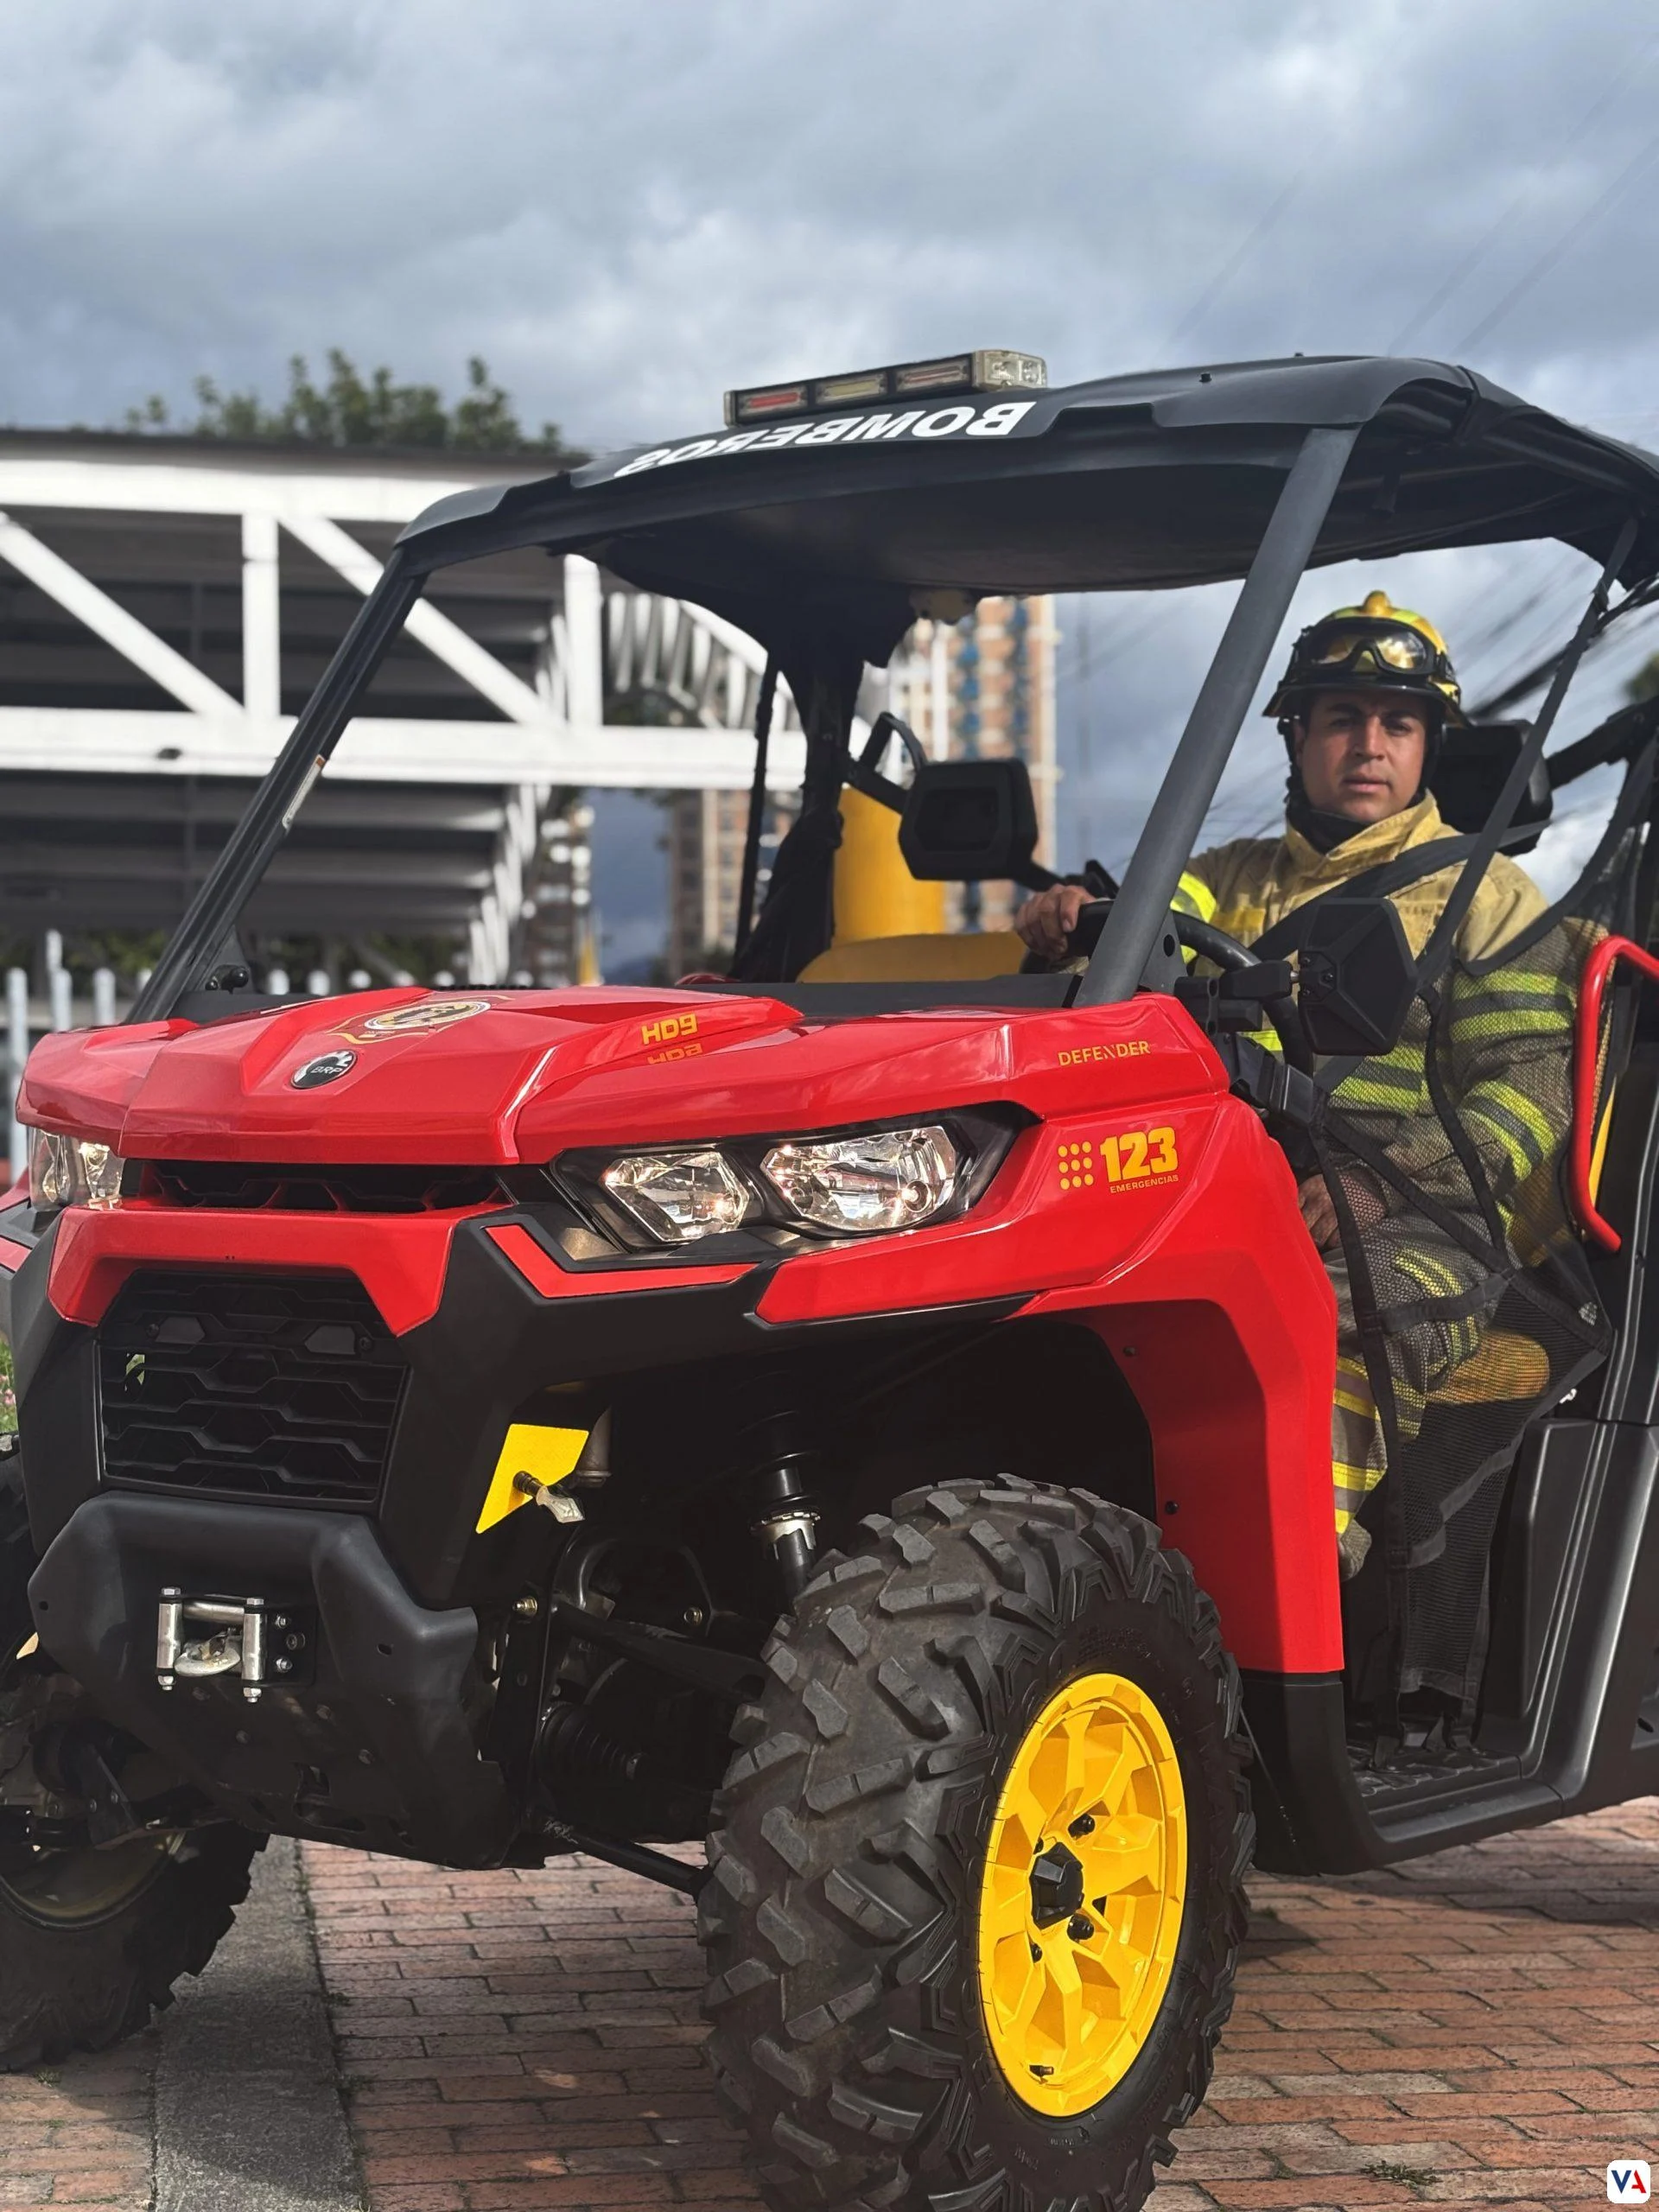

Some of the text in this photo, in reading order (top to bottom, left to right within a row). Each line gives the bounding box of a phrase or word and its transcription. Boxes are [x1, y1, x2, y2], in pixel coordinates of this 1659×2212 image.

[641, 1013, 698, 1046] HD9
[1058, 1040, 1150, 1066] DEFENDER
[310, 1065, 343, 1074] BRP
[1099, 1126, 1179, 1183] 123
[1109, 1174, 1179, 1193] EMERGENCIAS
